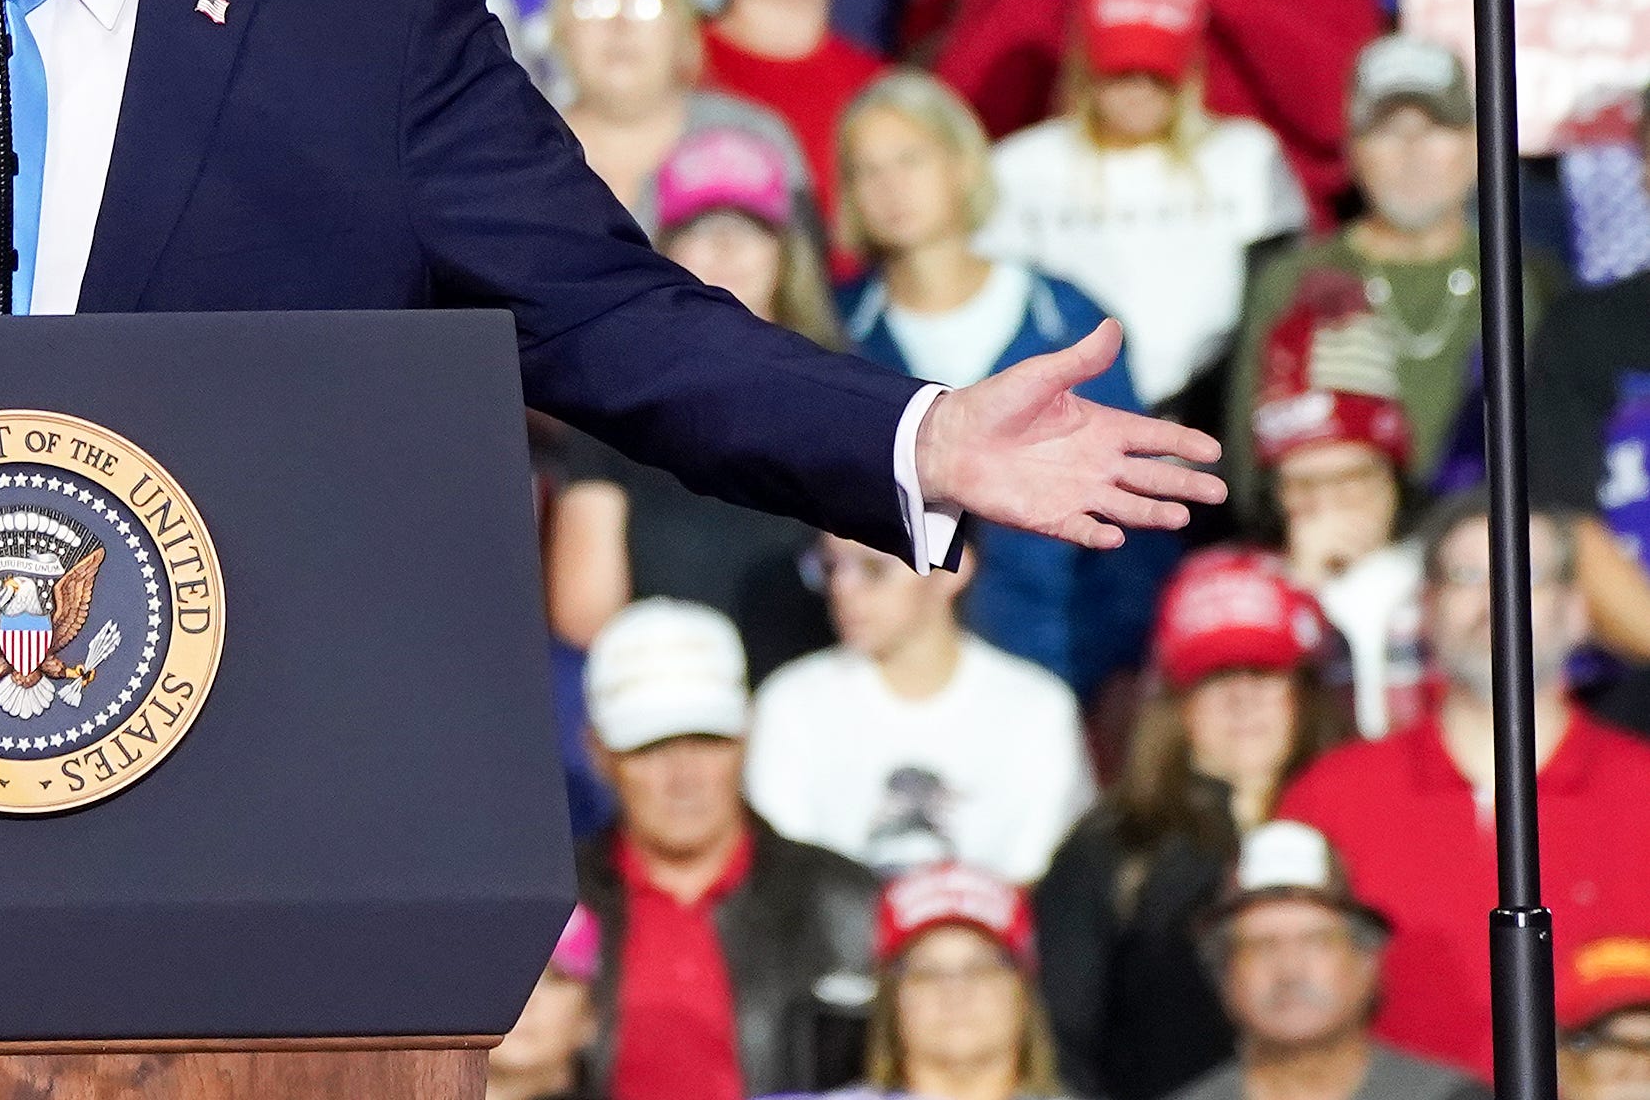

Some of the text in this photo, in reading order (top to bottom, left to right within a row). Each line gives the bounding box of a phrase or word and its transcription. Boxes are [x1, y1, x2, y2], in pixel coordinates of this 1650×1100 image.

[24, 430, 61, 453] OF
[70, 437, 119, 477] THE
[34, 563, 61, 573] UNUM
[129, 472, 211, 635] UNITED
[61, 672, 194, 792] STATES
